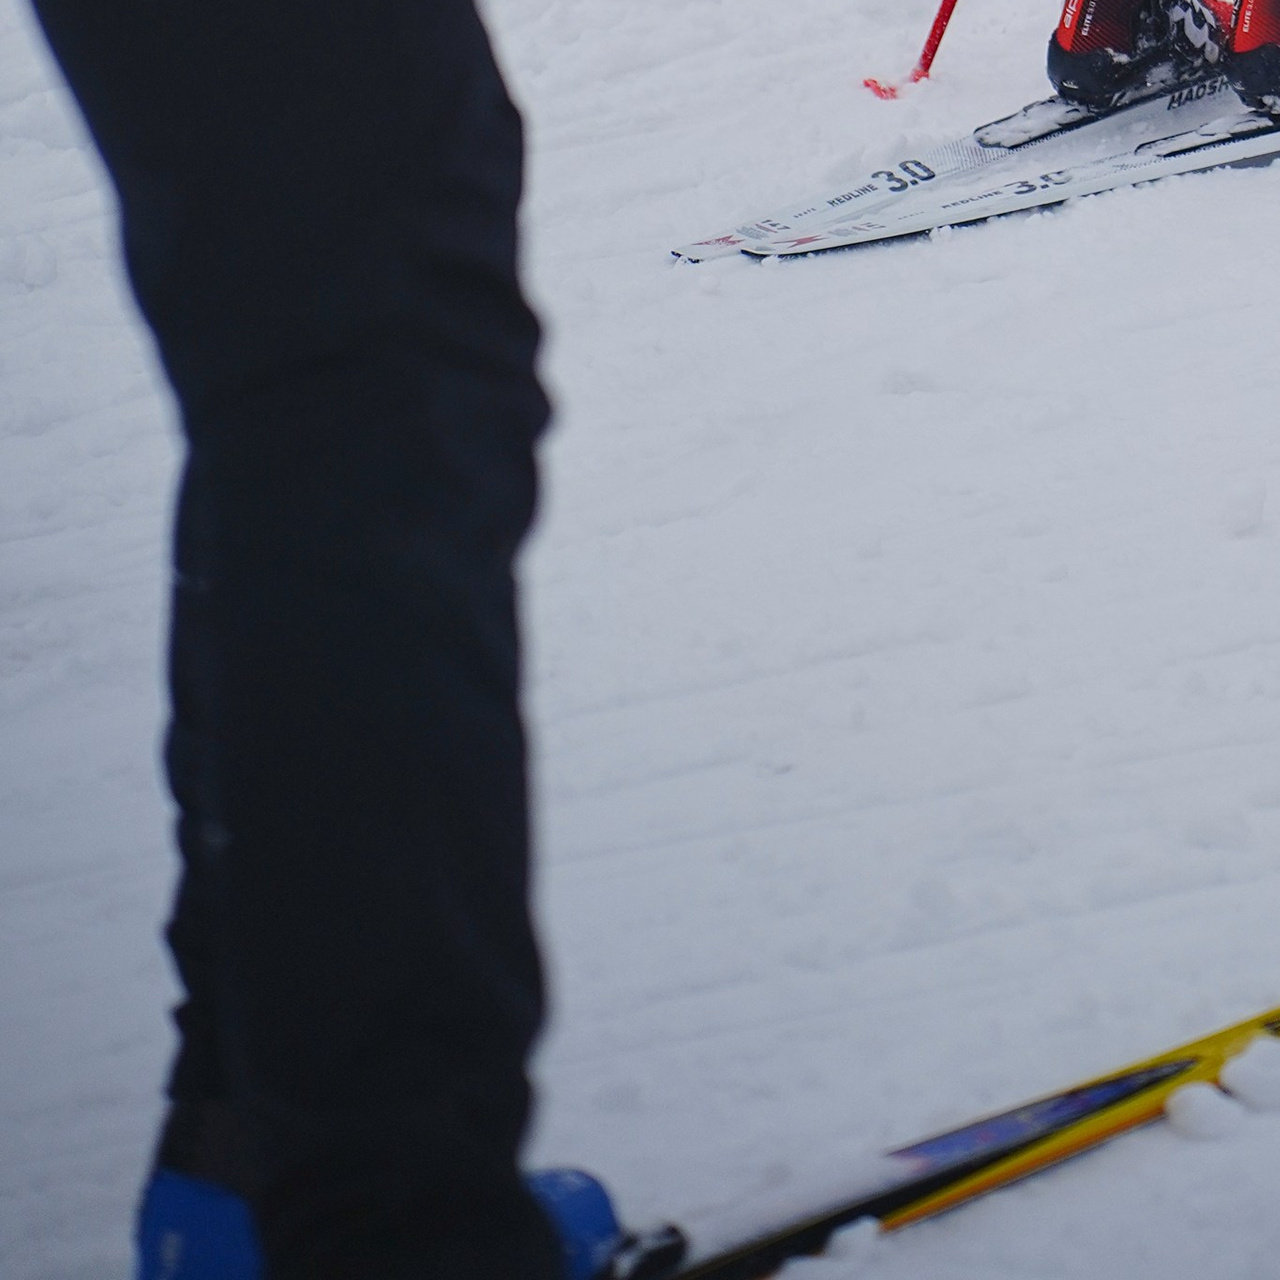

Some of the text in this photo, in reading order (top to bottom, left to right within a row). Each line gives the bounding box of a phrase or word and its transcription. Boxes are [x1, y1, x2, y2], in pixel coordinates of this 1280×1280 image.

[1081, 13, 1093, 36] ELITE
[827, 159, 936, 208] REDLINE 3.0
[942, 189, 1003, 209] REDLINE
